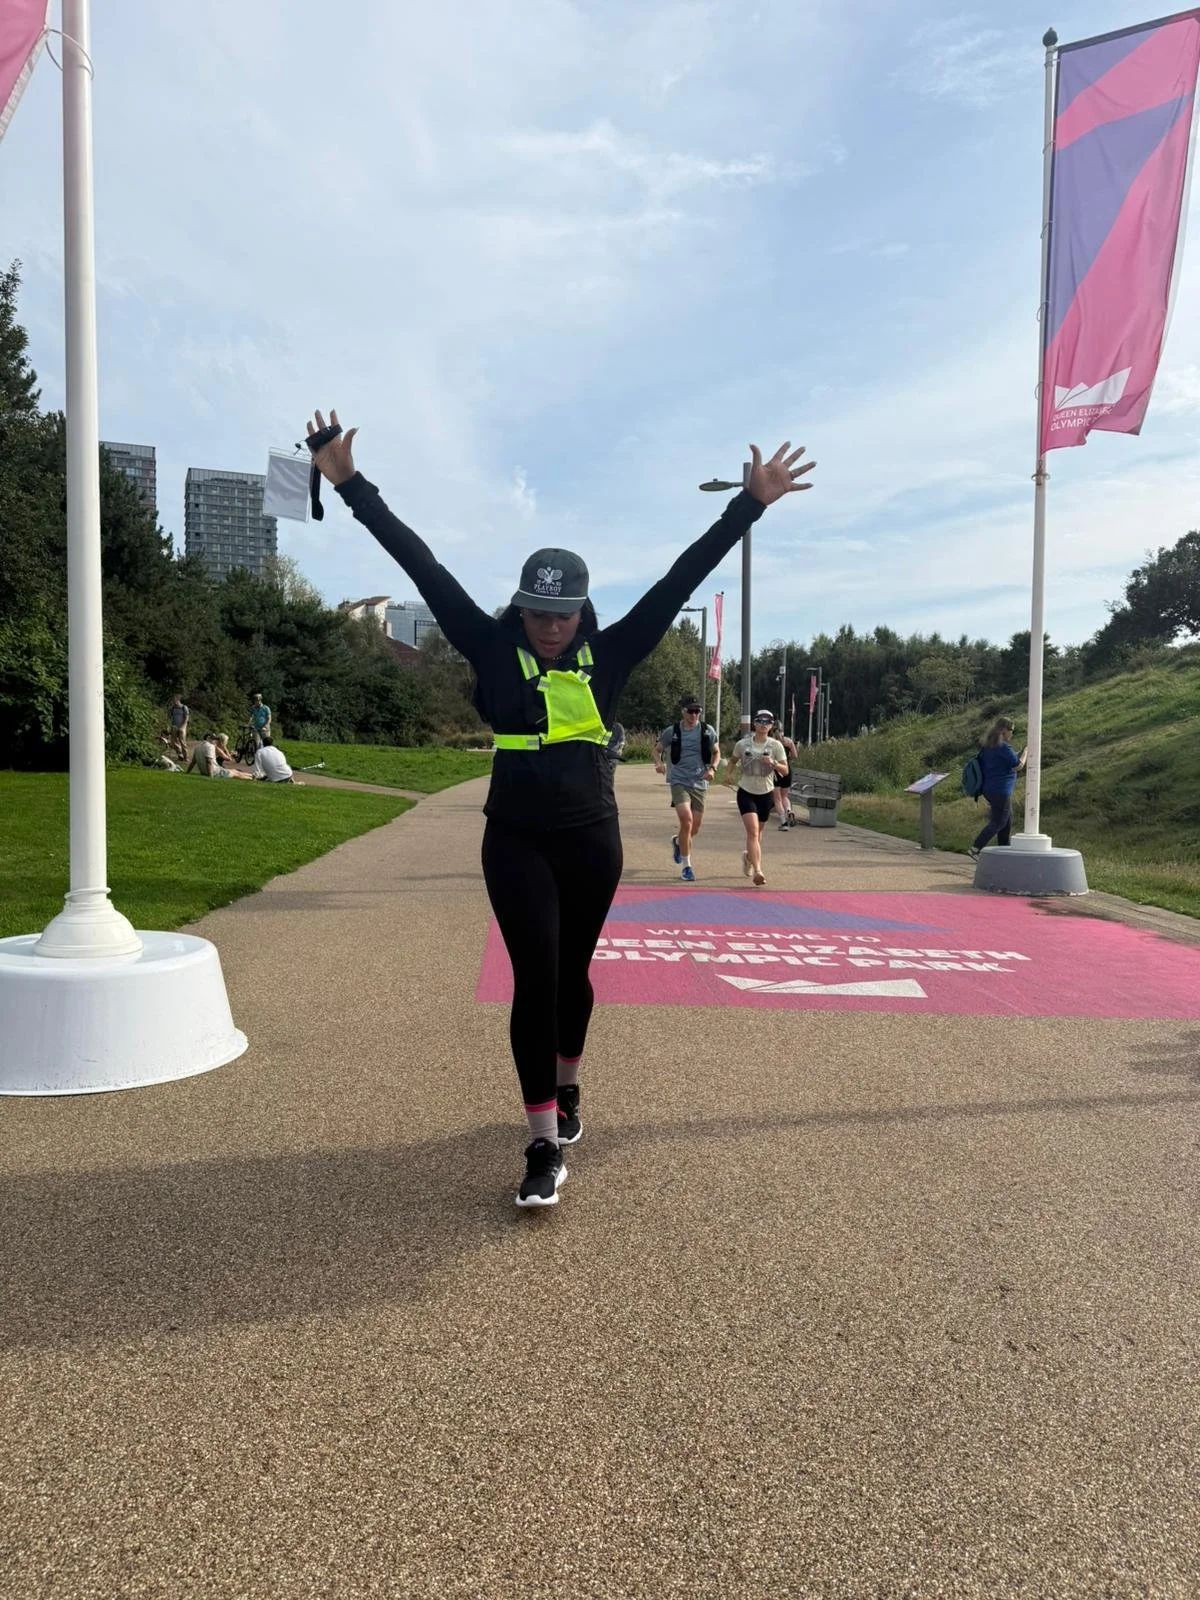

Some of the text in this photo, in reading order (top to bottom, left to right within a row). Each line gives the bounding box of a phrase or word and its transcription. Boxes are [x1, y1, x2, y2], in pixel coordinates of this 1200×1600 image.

[534, 583, 562, 593] PLAYBOY
[646, 929, 881, 943] WELCOME TO
[595, 938, 1032, 960] EEN ELIZABETH
[591, 950, 1017, 972] OLYMPIC PARK
